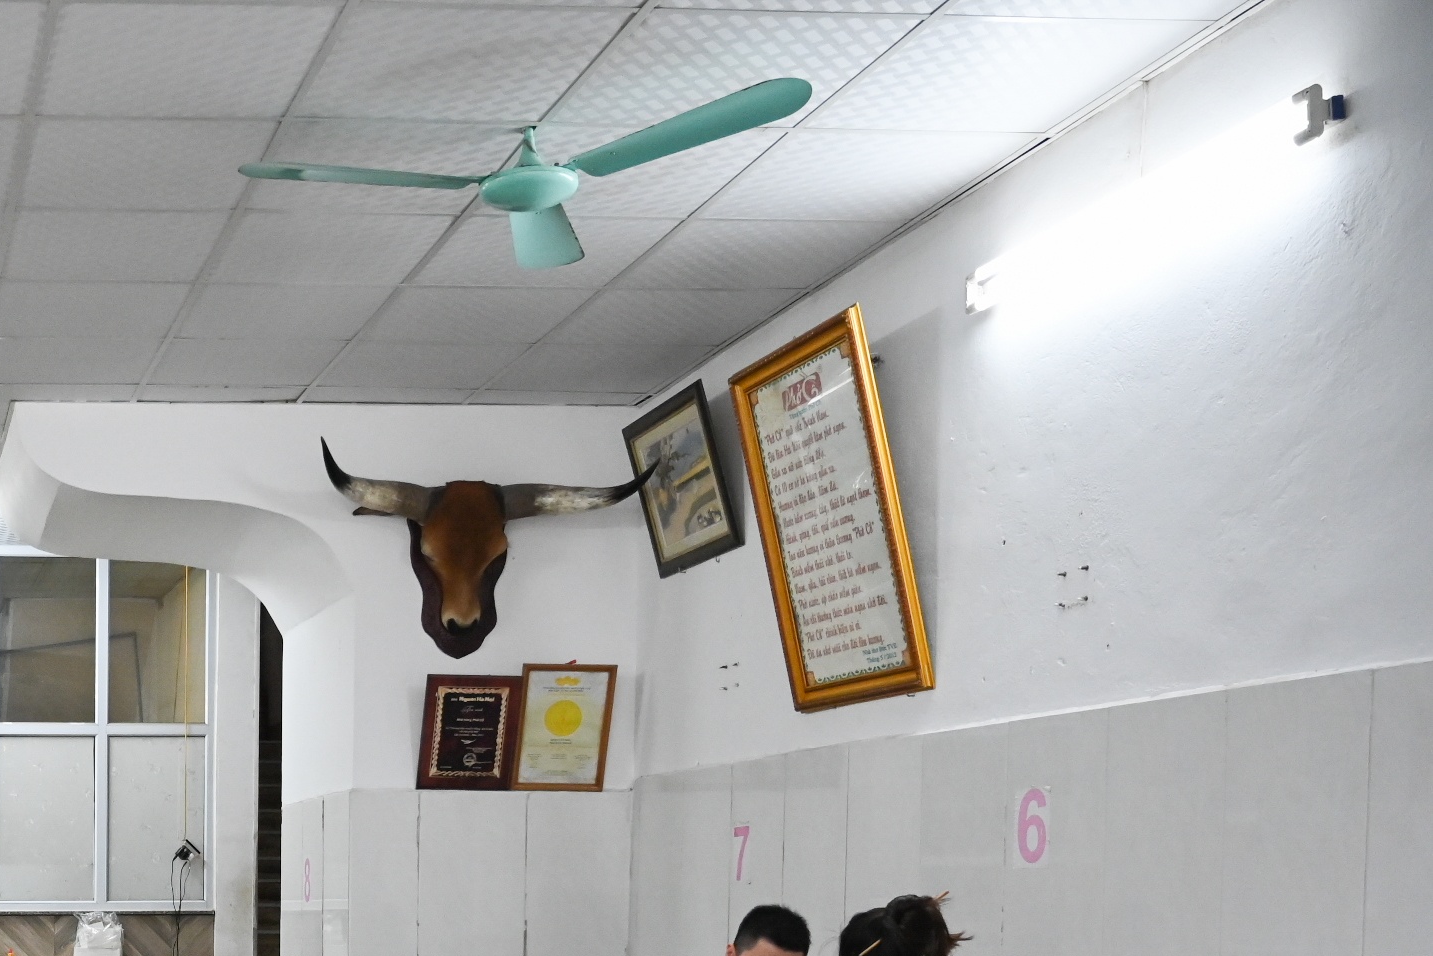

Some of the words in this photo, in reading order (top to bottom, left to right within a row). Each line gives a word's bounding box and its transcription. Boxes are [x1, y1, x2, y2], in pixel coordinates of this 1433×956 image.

[733, 825, 750, 881] 7
[1017, 788, 1047, 863] 6
[303, 857, 312, 903] 8
